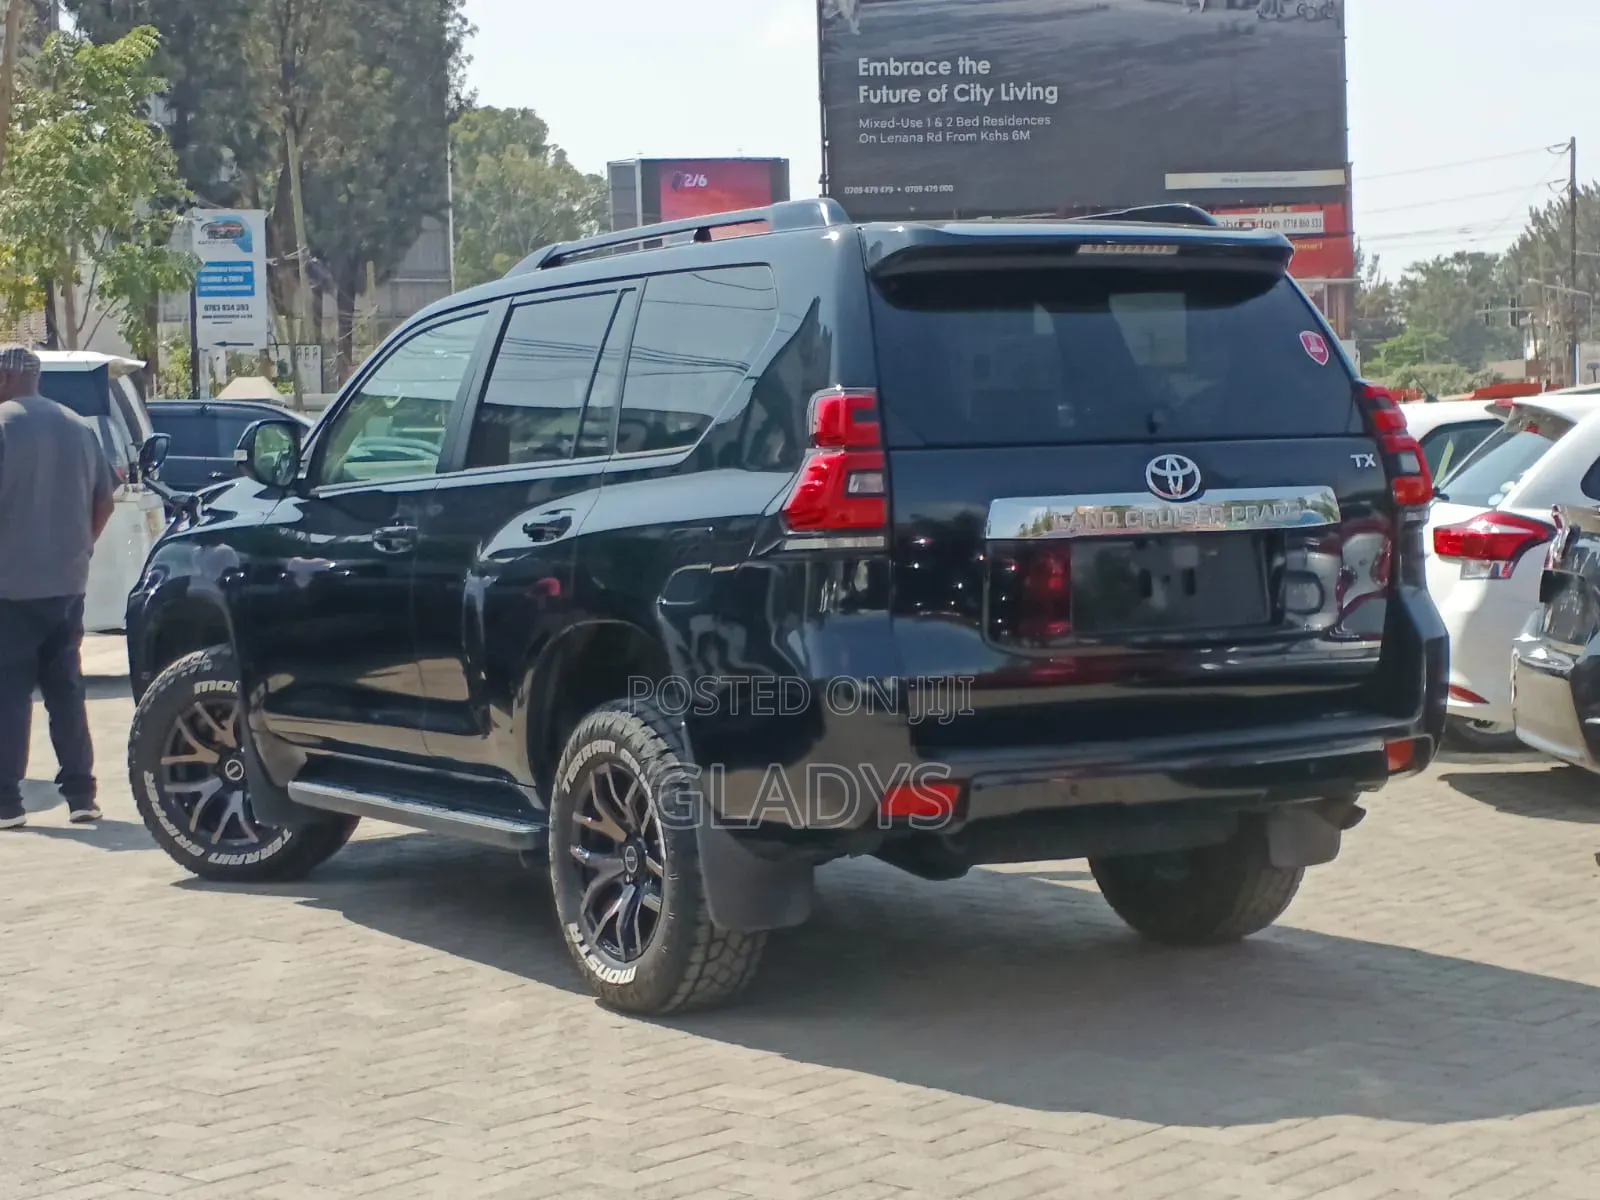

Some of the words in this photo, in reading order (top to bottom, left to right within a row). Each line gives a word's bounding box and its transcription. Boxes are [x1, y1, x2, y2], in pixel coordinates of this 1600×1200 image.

[858, 57, 951, 76] Embrace
[958, 56, 991, 75] the
[859, 85, 921, 104] Future
[927, 84, 949, 103] of
[953, 83, 994, 106] City
[1001, 82, 1058, 104] Living
[859, 117, 923, 129] Mixed-Use
[934, 117, 943, 127] &
[946, 117, 953, 127] 2
[956, 115, 979, 127] Bed
[983, 115, 1051, 126] Residences
[859, 133, 877, 144] On
[880, 132, 923, 143] Lenana
[927, 131, 943, 143] Rd
[946, 131, 977, 142] From
[980, 130, 1009, 142] Kshs
[1012, 129, 1031, 141] 6M
[1350, 453, 1377, 468] TX
[1052, 510, 1118, 529] LAND
[1125, 505, 1223, 528] CRUISER
